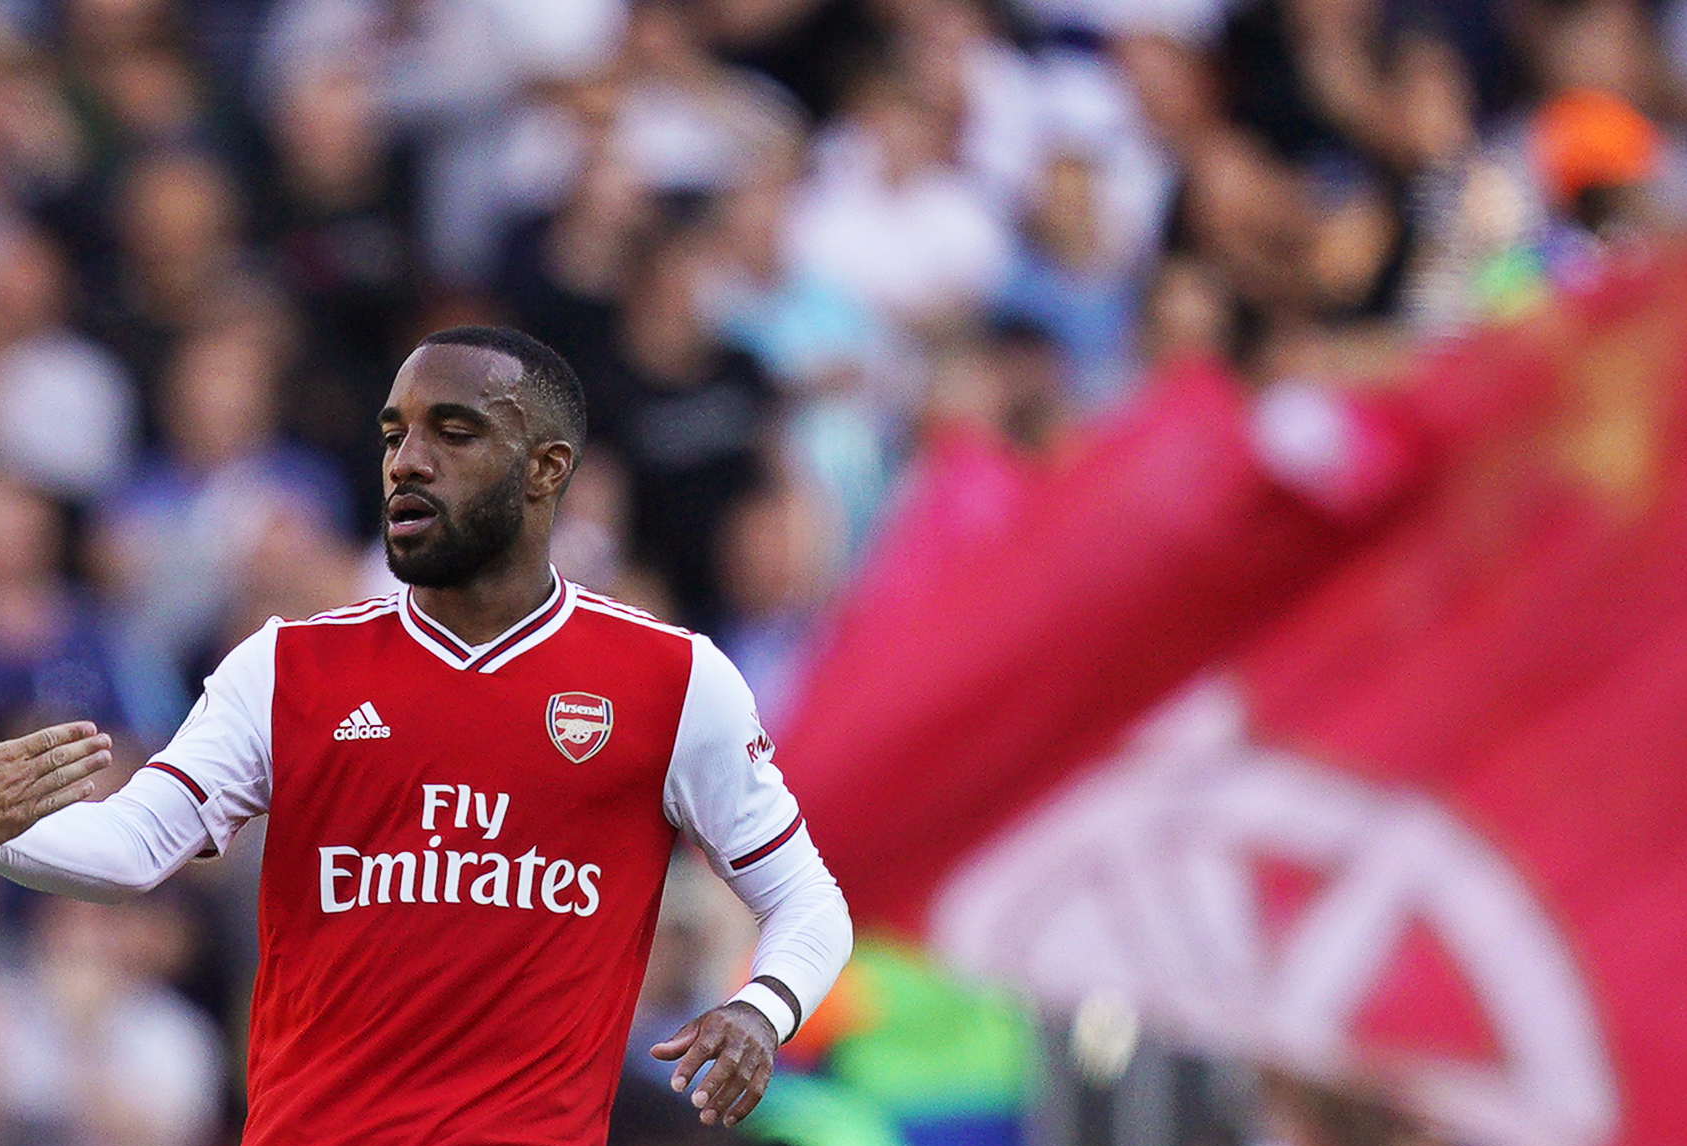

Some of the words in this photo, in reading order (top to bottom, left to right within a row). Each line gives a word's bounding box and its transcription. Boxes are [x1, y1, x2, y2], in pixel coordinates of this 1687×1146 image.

[556, 701, 604, 717] Arsenal
[333, 725, 391, 741] adidas
[421, 783, 511, 840] Fly
[317, 835, 602, 917] Emirates
